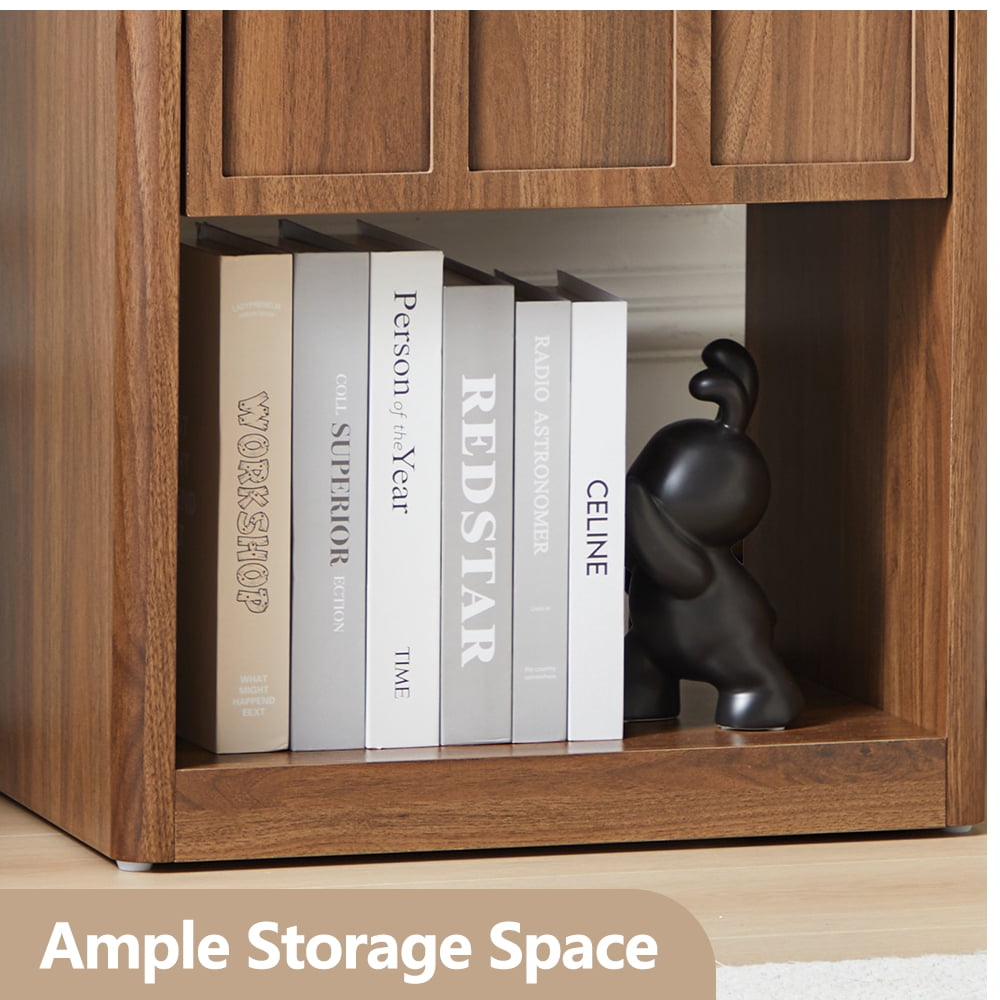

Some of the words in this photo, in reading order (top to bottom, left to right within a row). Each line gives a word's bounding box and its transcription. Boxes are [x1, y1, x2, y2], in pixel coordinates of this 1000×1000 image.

[393, 290, 417, 396] Person
[534, 335, 550, 402] RADIO
[389, 400, 407, 420] of
[391, 425, 407, 451] the
[236, 390, 270, 614] WORKSHOP
[329, 422, 351, 567] SUPERIOR
[391, 446, 415, 514] Year
[461, 373, 496, 668] REDSTAR
[533, 411, 550, 556] ASTRONOMER
[586, 479, 609, 576] CELINE
[332, 576, 345, 633] ECTION
[394, 646, 411, 700] TIME
